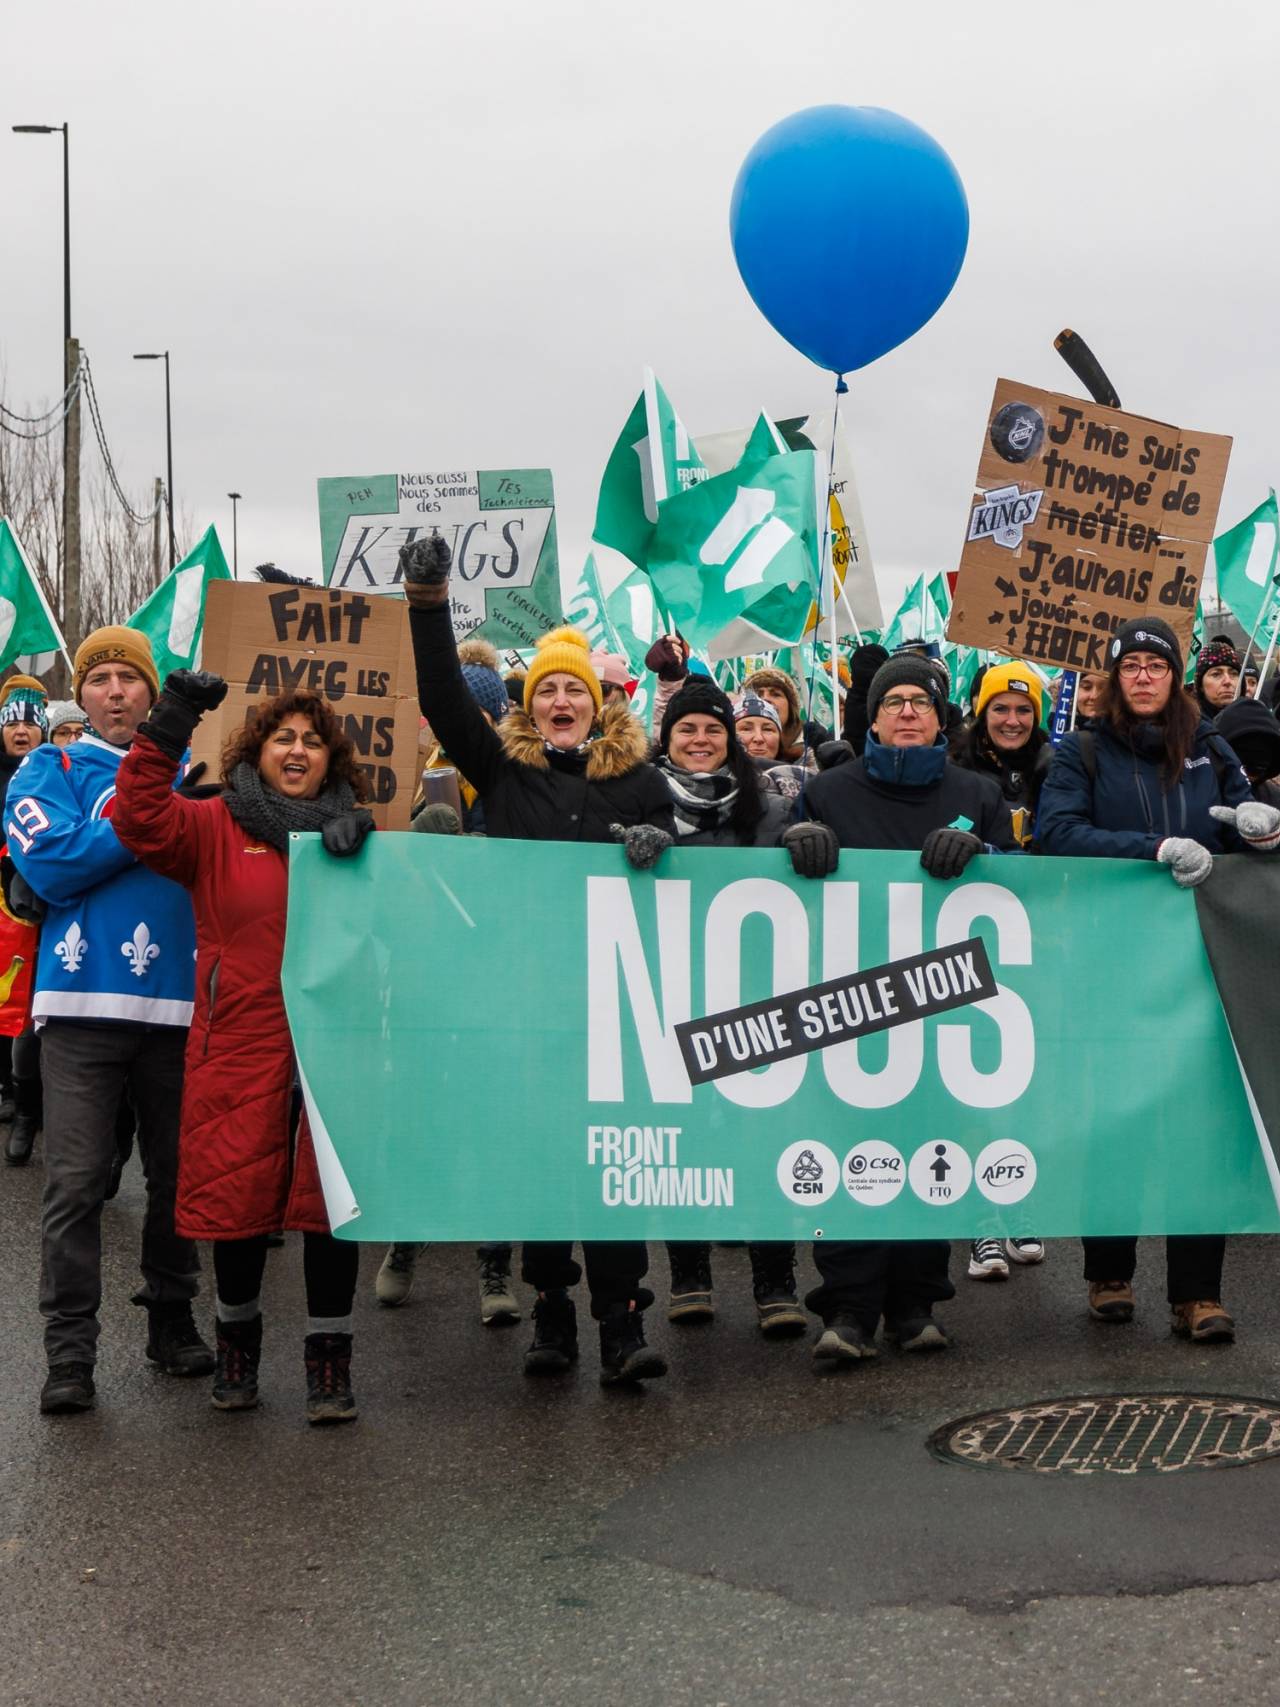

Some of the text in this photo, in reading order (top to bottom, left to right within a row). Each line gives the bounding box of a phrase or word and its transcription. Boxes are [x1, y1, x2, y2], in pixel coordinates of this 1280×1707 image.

[1050, 405, 1200, 475] J'me suis
[400, 486, 478, 500] Nous sommes
[401, 472, 467, 486] Nous aussi
[1043, 449, 1201, 516] trompé de
[417, 500, 441, 513] des
[975, 492, 1036, 535] KINGS
[1019, 540, 1197, 609] J'aurais dû
[450, 597, 471, 615] tre
[1009, 589, 1079, 625] jouer
[452, 617, 482, 632] ssion
[83, 650, 110, 666] VANS
[245, 653, 390, 701] AVEC LES
[9, 797, 50, 855] 19
[586, 876, 1035, 1109] NOUS
[691, 951, 983, 1073] D'UNE SEULE VOIX
[587, 1126, 681, 1168] FRONT
[870, 1157, 901, 1171] CSQ
[603, 1167, 734, 1207] COMMUN
[792, 1182, 823, 1194] CSN
[982, 1165, 1025, 1179] APTS
[929, 1187, 951, 1198] FTQ
